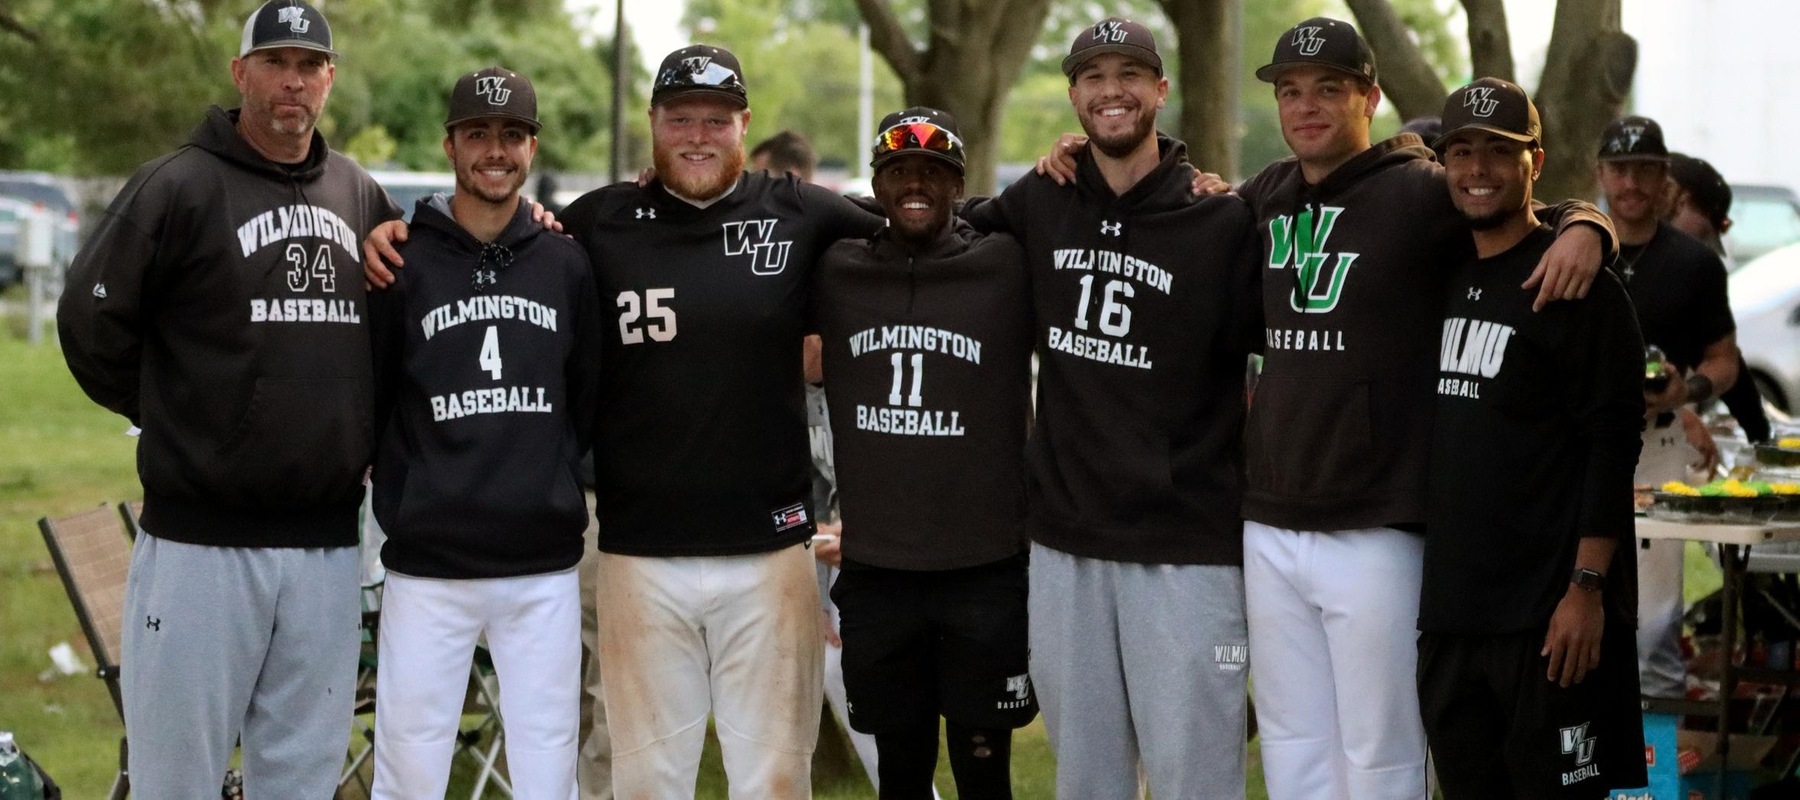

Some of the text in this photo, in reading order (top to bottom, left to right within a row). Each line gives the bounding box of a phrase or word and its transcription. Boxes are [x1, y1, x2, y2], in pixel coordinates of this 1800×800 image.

[277, 6, 310, 33] WU
[1092, 21, 1128, 44] WU
[1291, 26, 1326, 56] WU
[475, 76, 512, 106] WU
[1463, 87, 1500, 118] WU
[286, 243, 335, 293] 34
[722, 218, 793, 276] WU
[1268, 206, 1361, 314] WU
[1053, 248, 1173, 295] WILMINGTON
[250, 299, 360, 324] BASEBALL
[421, 295, 557, 341] WILMINGTON
[616, 287, 678, 345] 25
[1074, 274, 1135, 338] 16
[479, 325, 502, 381] 4
[849, 325, 982, 365] WILMINGTON
[1048, 326, 1153, 370] BASEBALL
[888, 352, 924, 407] 11
[431, 386, 553, 422] BASEBALL
[856, 405, 965, 437] BASEBALL
[1215, 645, 1247, 663] WILMU
[1559, 721, 1597, 767] WU
[1562, 763, 1600, 786] BASEBALL
